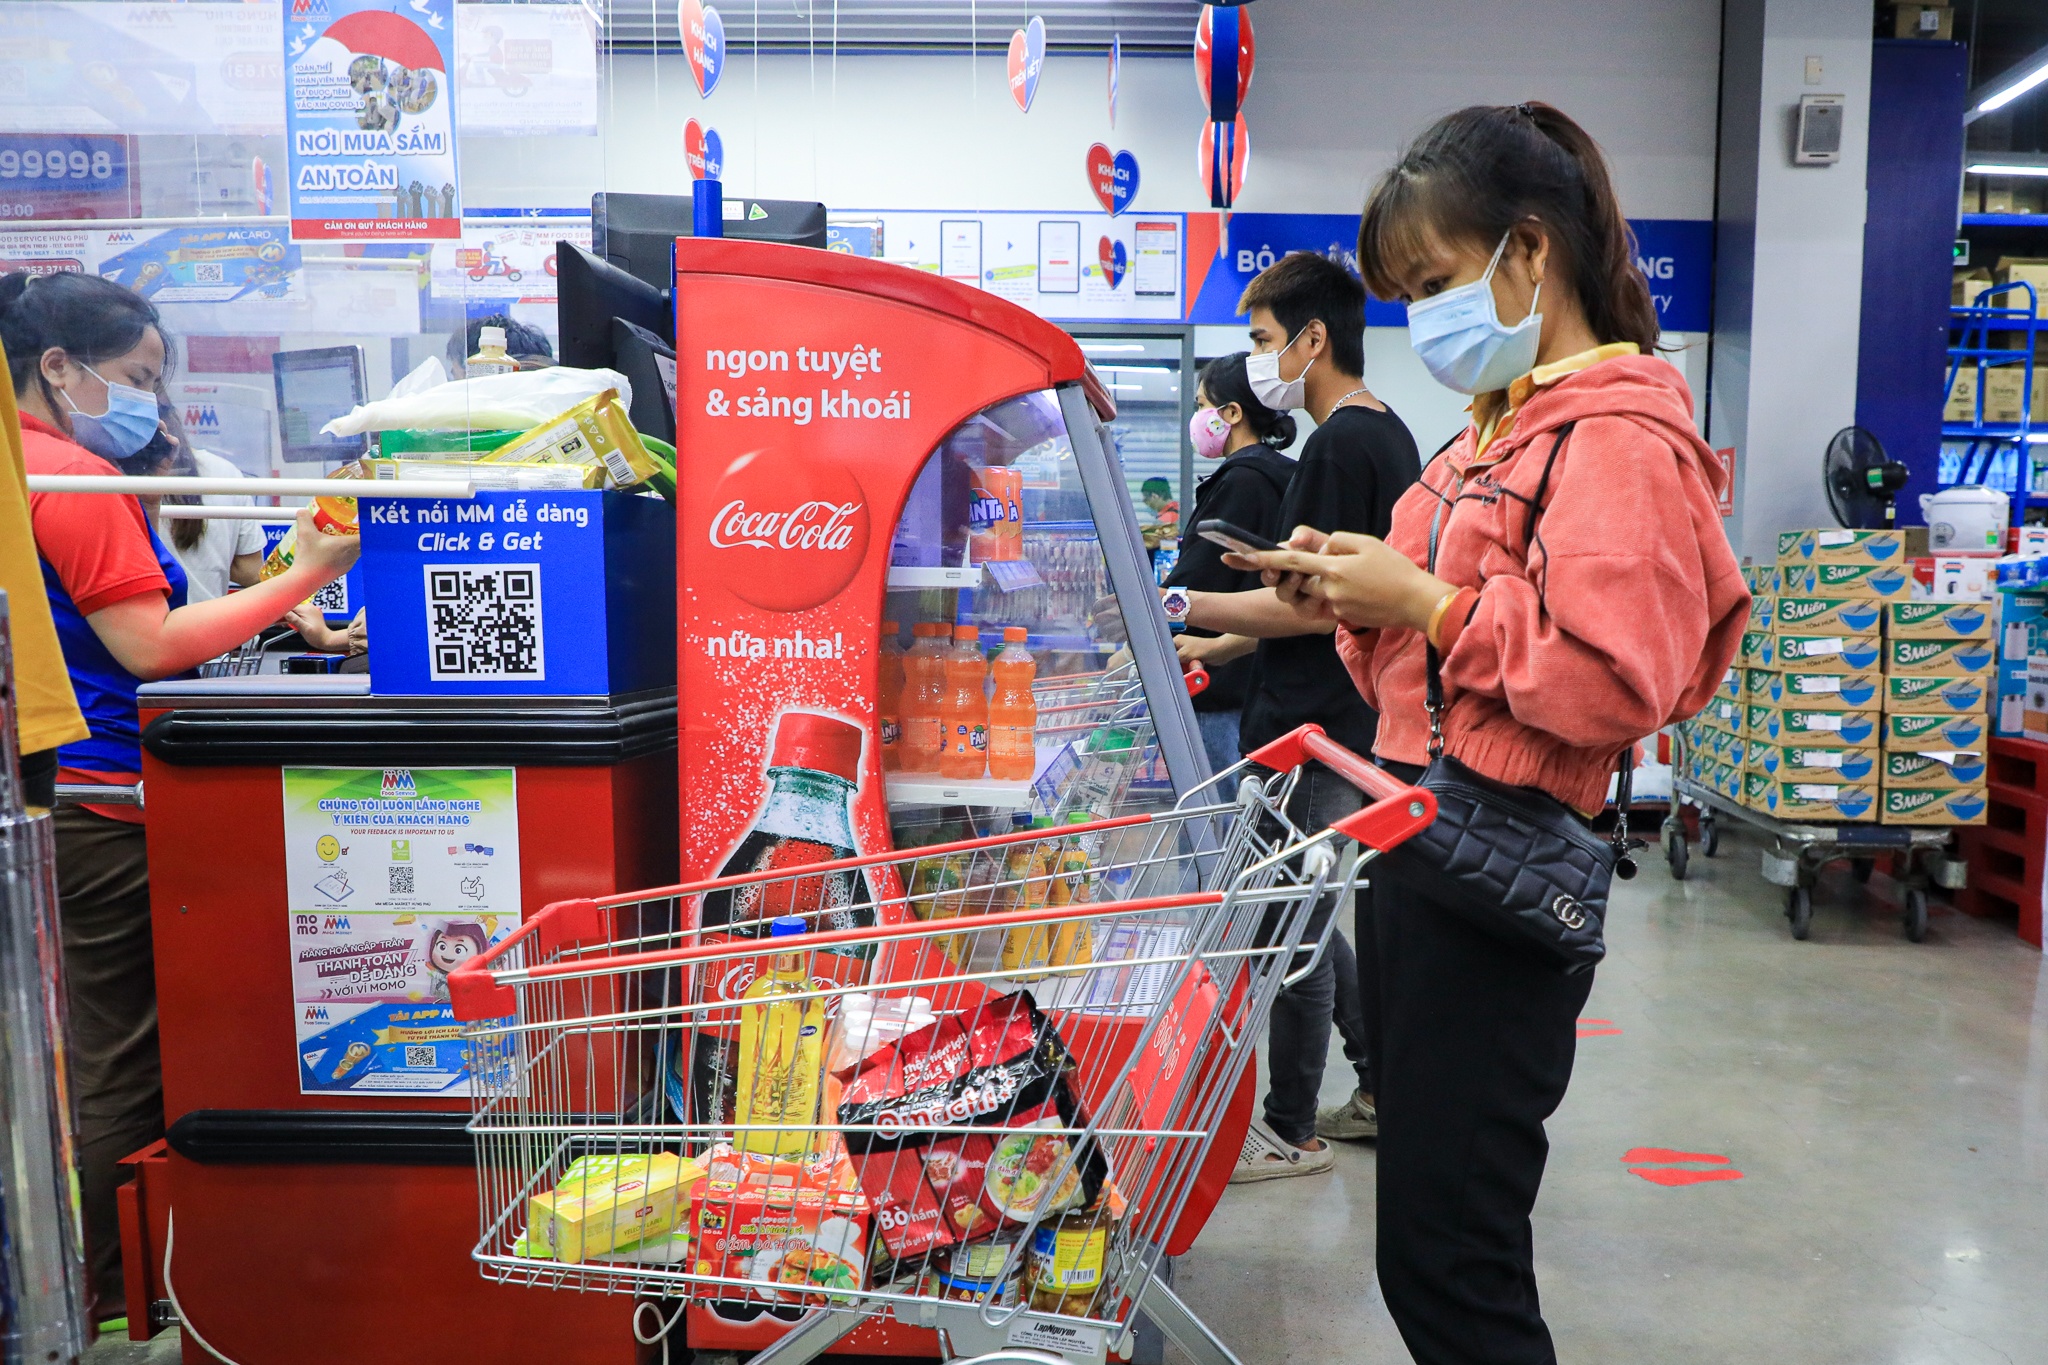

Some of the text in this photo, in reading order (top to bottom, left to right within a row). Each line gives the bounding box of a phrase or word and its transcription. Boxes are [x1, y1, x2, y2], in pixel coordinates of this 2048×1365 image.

[1020, 47, 1030, 63] LÀ
[295, 75, 317, 84] NHÂN
[319, 75, 335, 84] VIÊN
[300, 124, 441, 151] NƠI MUA SẮM
[0, 150, 112, 179] 99998
[301, 164, 394, 186] AN TOÀN
[1098, 163, 1130, 181] KHÁCH
[1100, 181, 1127, 199] HÀNG
[228, 230, 272, 240] MCARD
[324, 219, 428, 230] CẢM ƠN QUÝ KHÁCH HÀNG
[14, 235, 47, 243] SERVICE
[706, 343, 881, 382] ngon tuyệt
[705, 387, 910, 426] & sảng khoái
[371, 499, 589, 528] Kết nối MM dễ dàng
[708, 499, 863, 551] Coca-Cola
[417, 531, 544, 552] Click & Get
[707, 632, 843, 659] nữa nha!
[319, 795, 480, 811] CHÚNG TÔI LUÔN LẮNG NGHE
[343, 811, 369, 825] KIẾN
[373, 812, 394, 825] CỦA
[397, 812, 435, 825] KHÁCH
[438, 811, 471, 825] HÀNG
[302, 937, 405, 959] HÀNG HOÁ NGẬP TRÀN
[316, 951, 402, 973] THANH TOÁN
[349, 962, 416, 984] DỄ DÀNG
[334, 980, 406, 996] VỚI VÍ MOMO
[412, 1010, 440, 1020] APP
[875, 1084, 999, 1140] Omachi
[879, 1204, 939, 1232] Bò hầm
[1033, 1322, 1077, 1337] LapNguyen
